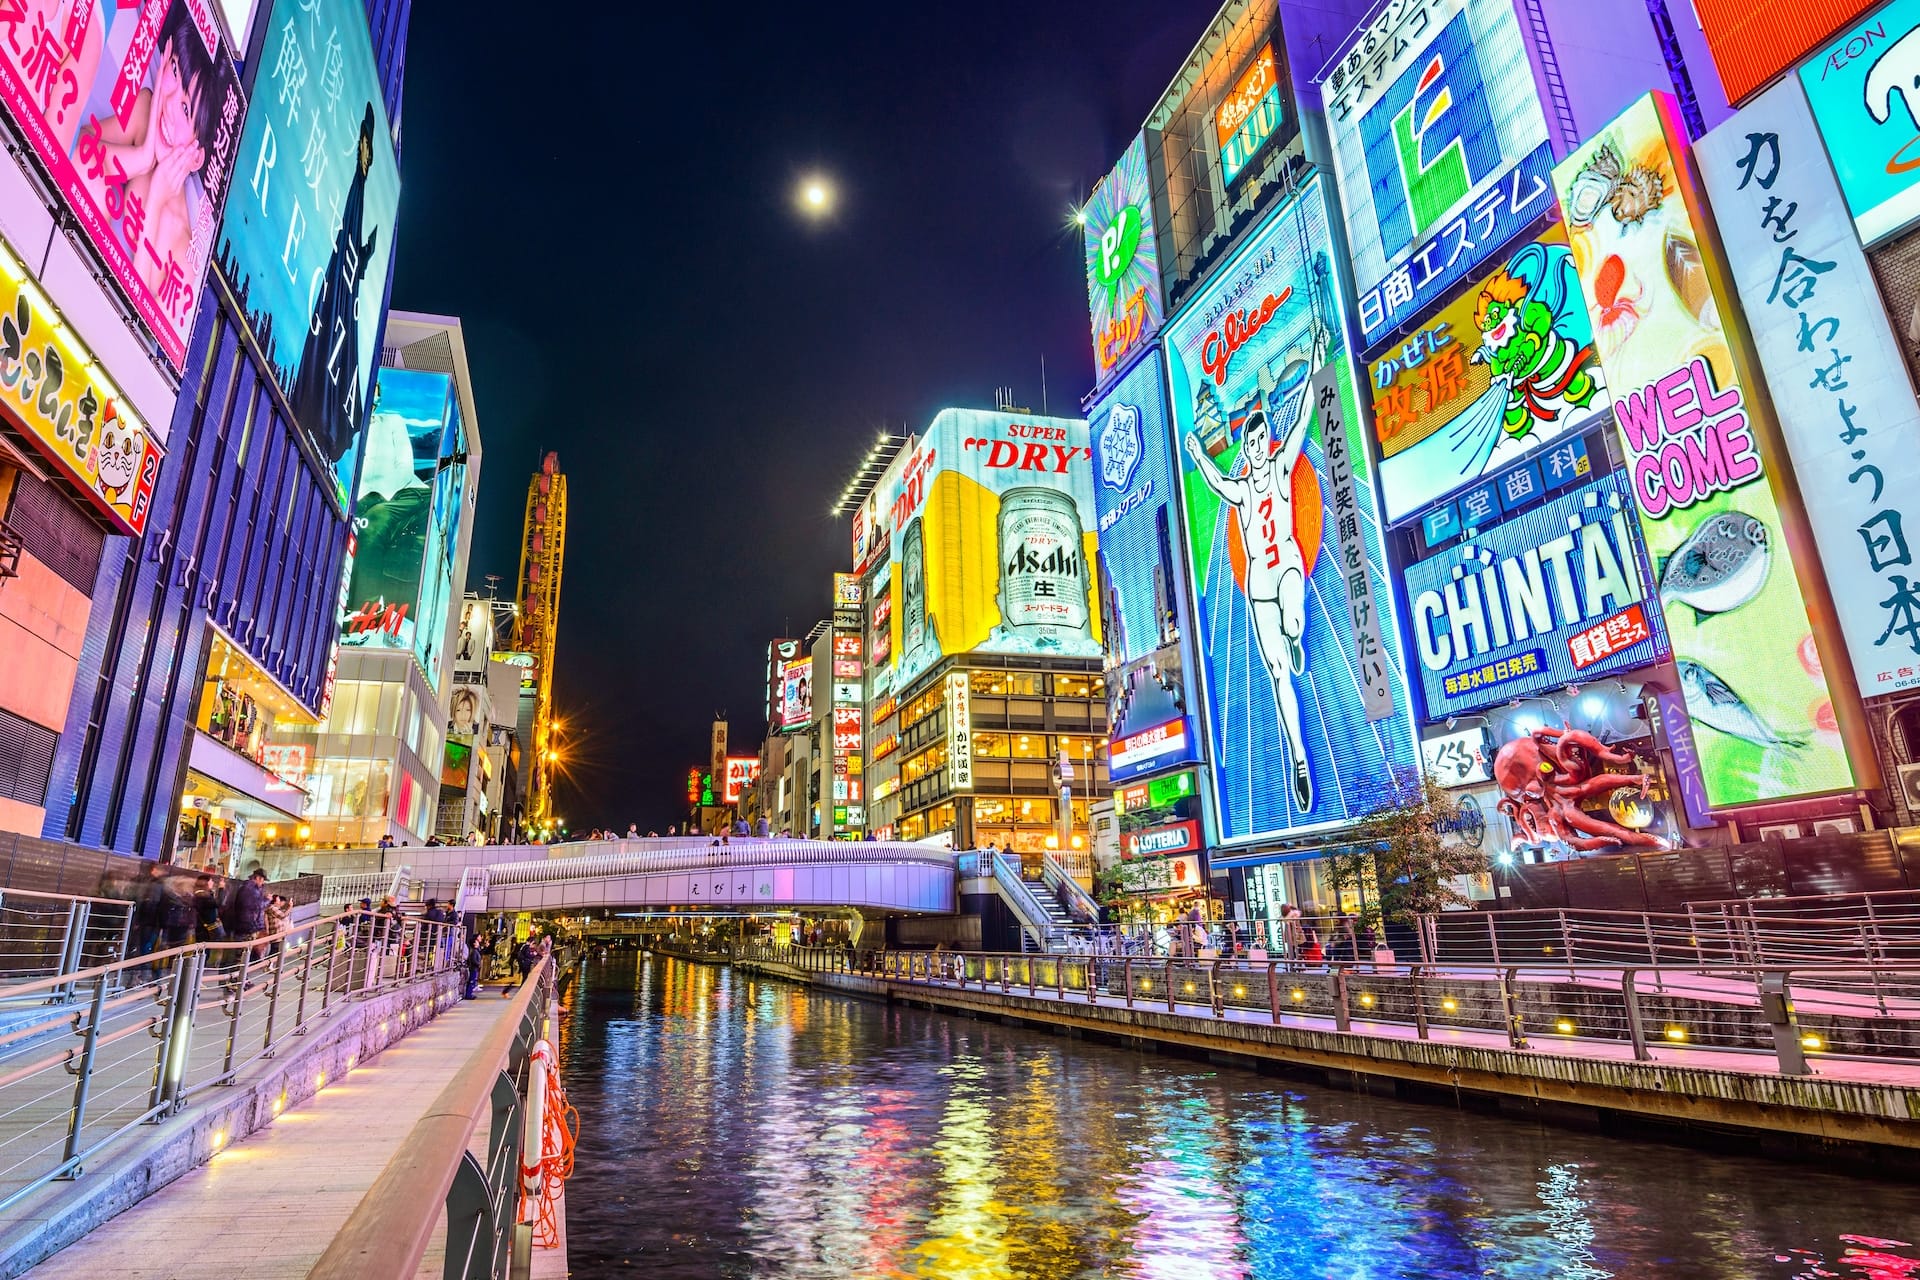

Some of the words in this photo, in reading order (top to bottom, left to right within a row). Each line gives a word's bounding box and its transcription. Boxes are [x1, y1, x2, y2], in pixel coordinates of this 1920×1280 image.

[249, 112, 359, 429] REGZA
[1358, 169, 1548, 335] 日商エステム
[1099, 285, 1146, 370] ピップ
[1201, 285, 1293, 387] Glico
[1373, 320, 1450, 390] かぜに
[1371, 342, 1469, 443] 改源
[1614, 359, 1740, 454] WEL
[1007, 423, 1067, 441] SUPER
[1635, 413, 1759, 516] COME
[132, 456, 157, 522] 2F
[1008, 541, 1078, 579] Asahi
[1257, 490, 1280, 570] グリコ
[1319, 383, 1385, 699] みんなに笑顔を届けたい。
[348, 601, 410, 637] H&M
[1024, 603, 1069, 614] スーパードライ
[1033, 580, 1057, 597] 生
[1414, 510, 1642, 671] CHINTAI
[1570, 627, 1612, 668] 賃貸
[1605, 613, 1631, 635] 住宅
[1444, 653, 1539, 695] 毎週水曜日発売
[1646, 696, 1661, 735] 2F
[1139, 829, 1184, 851] LOTTERIA
